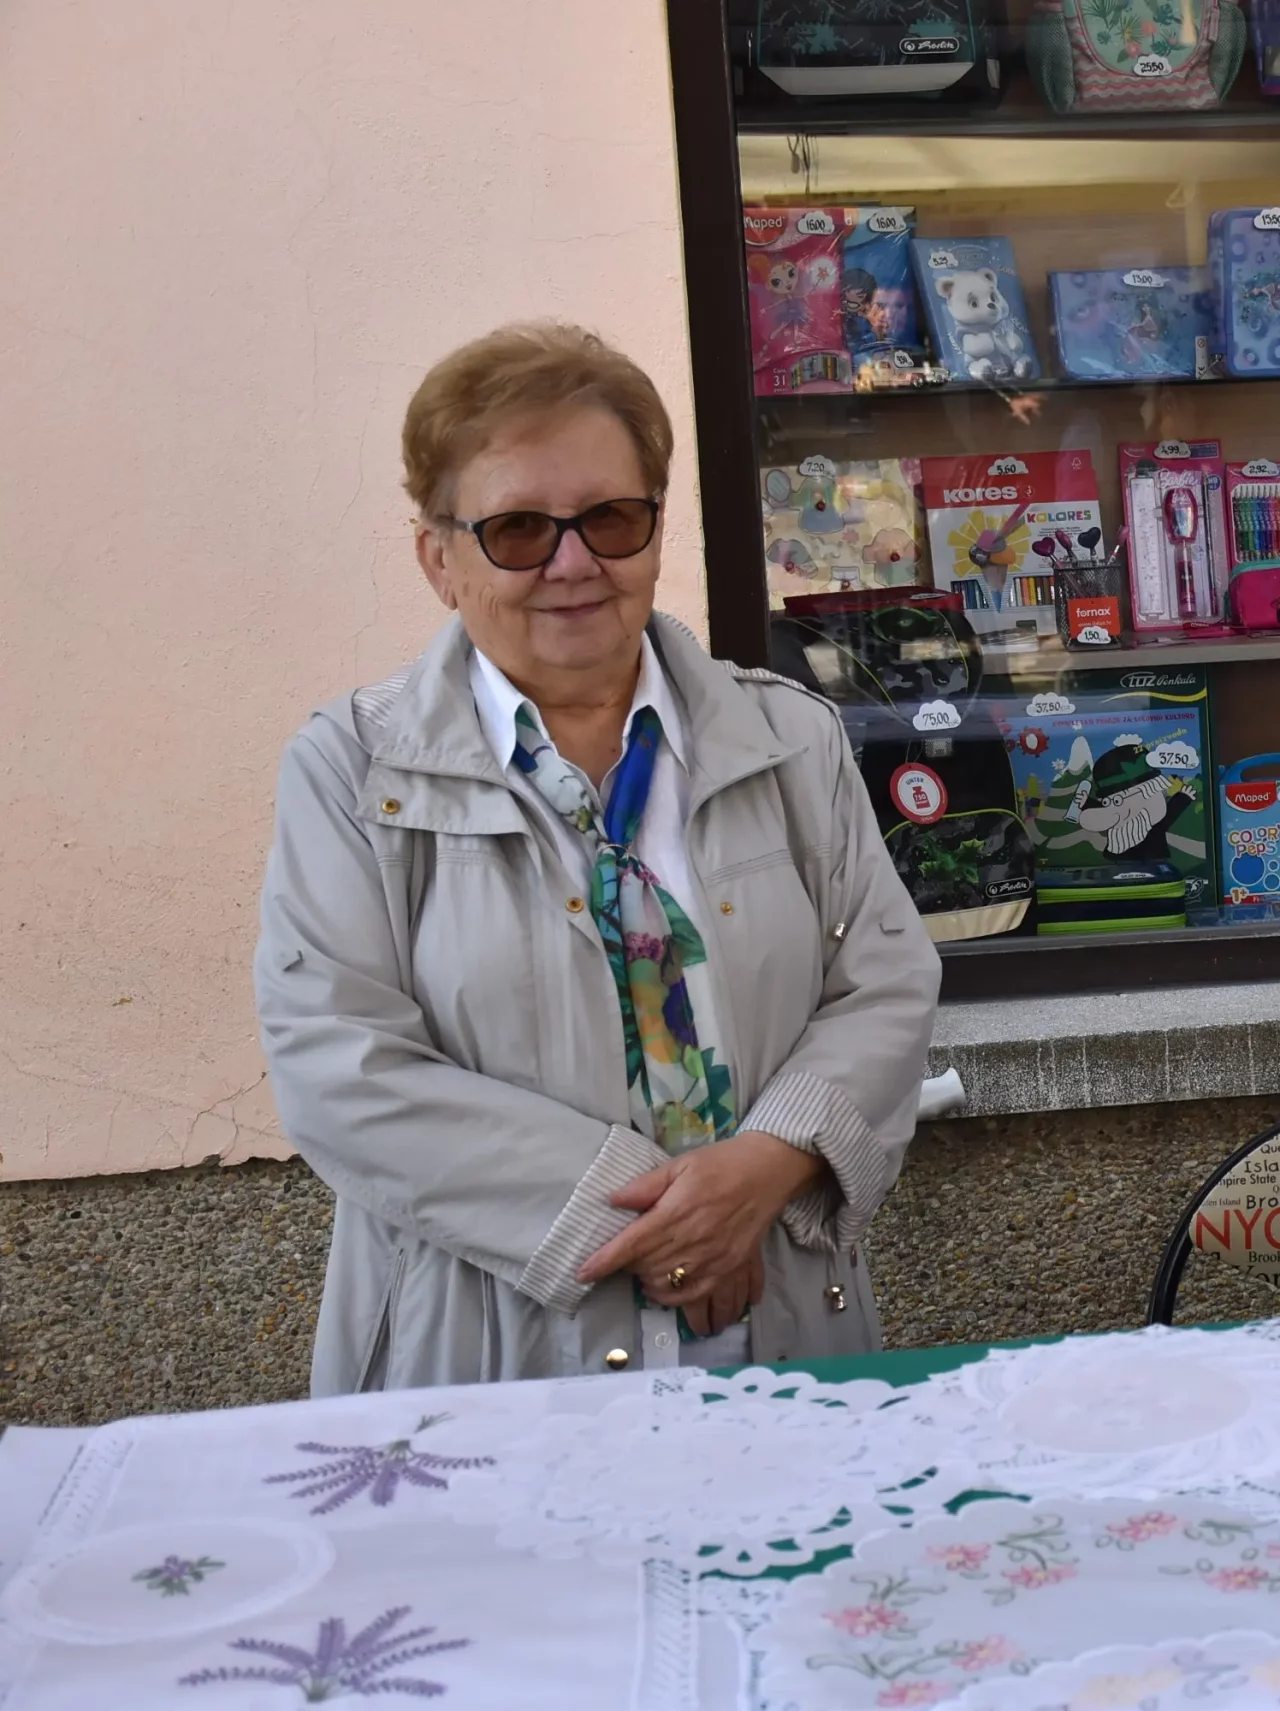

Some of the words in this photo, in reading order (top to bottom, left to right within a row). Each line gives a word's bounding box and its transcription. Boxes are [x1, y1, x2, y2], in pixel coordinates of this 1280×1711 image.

[744, 215, 783, 229] Maped
[773, 375, 786, 387] 31
[943, 485, 1018, 504] kores
[1026, 509, 1092, 524] KOLORES
[1076, 606, 1111, 618] fornax
[1234, 792, 1270, 803] Maped
[1249, 1174, 1277, 1185] State
[1219, 1197, 1241, 1206] Island
